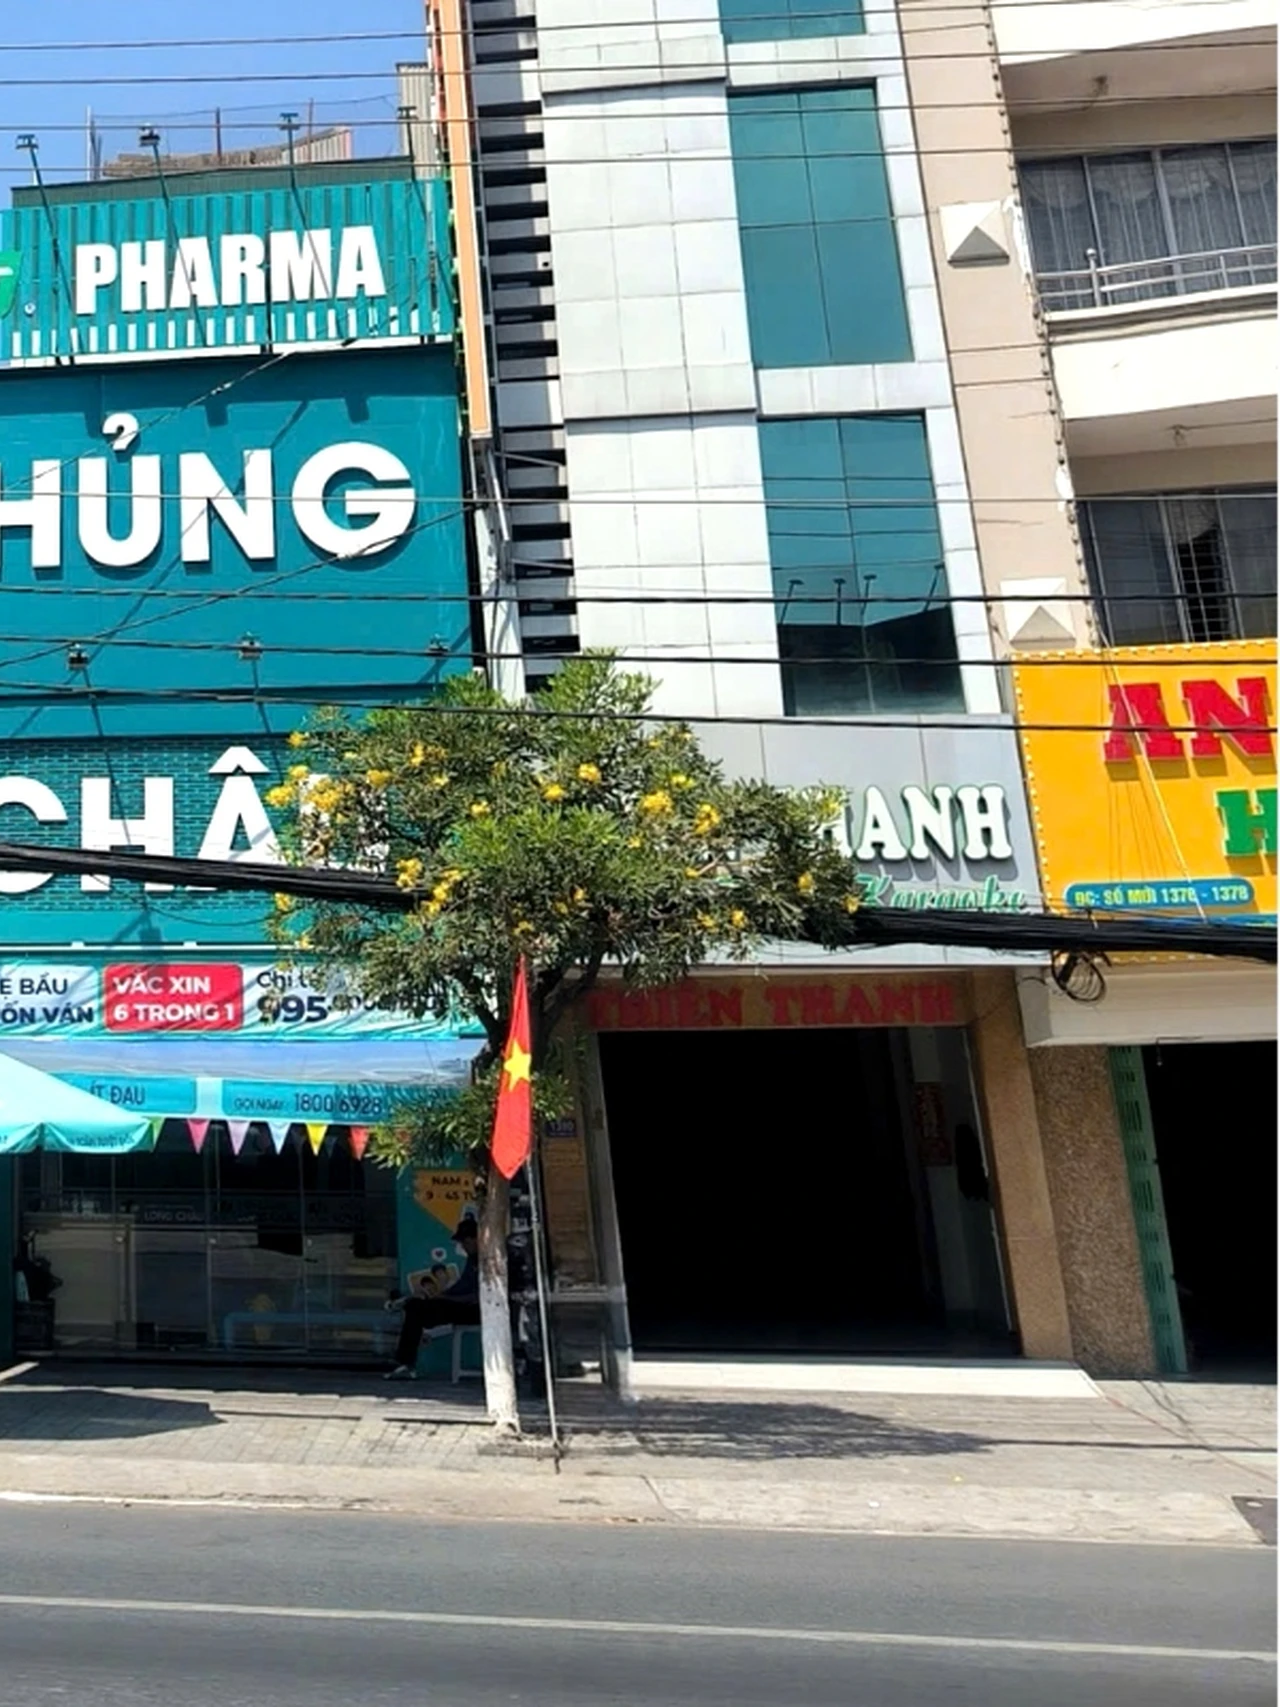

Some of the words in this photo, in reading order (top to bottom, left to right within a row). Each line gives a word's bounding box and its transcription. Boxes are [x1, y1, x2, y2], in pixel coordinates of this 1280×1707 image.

[76, 225, 387, 316] PHARMA
[1103, 676, 1273, 760] AN
[168, 976, 211, 994] XIN
[41, 1002, 94, 1024] VÁN
[113, 1003, 129, 1021] 6
[133, 1003, 219, 1021] TRONG
[223, 1003, 235, 1021] 1
[763, 983, 956, 1026] THANH
[110, 1086, 145, 1105] ĐAU
[294, 1094, 333, 1112] 1800
[339, 1095, 382, 1115] 6928
[432, 1176, 461, 1185] NAM
